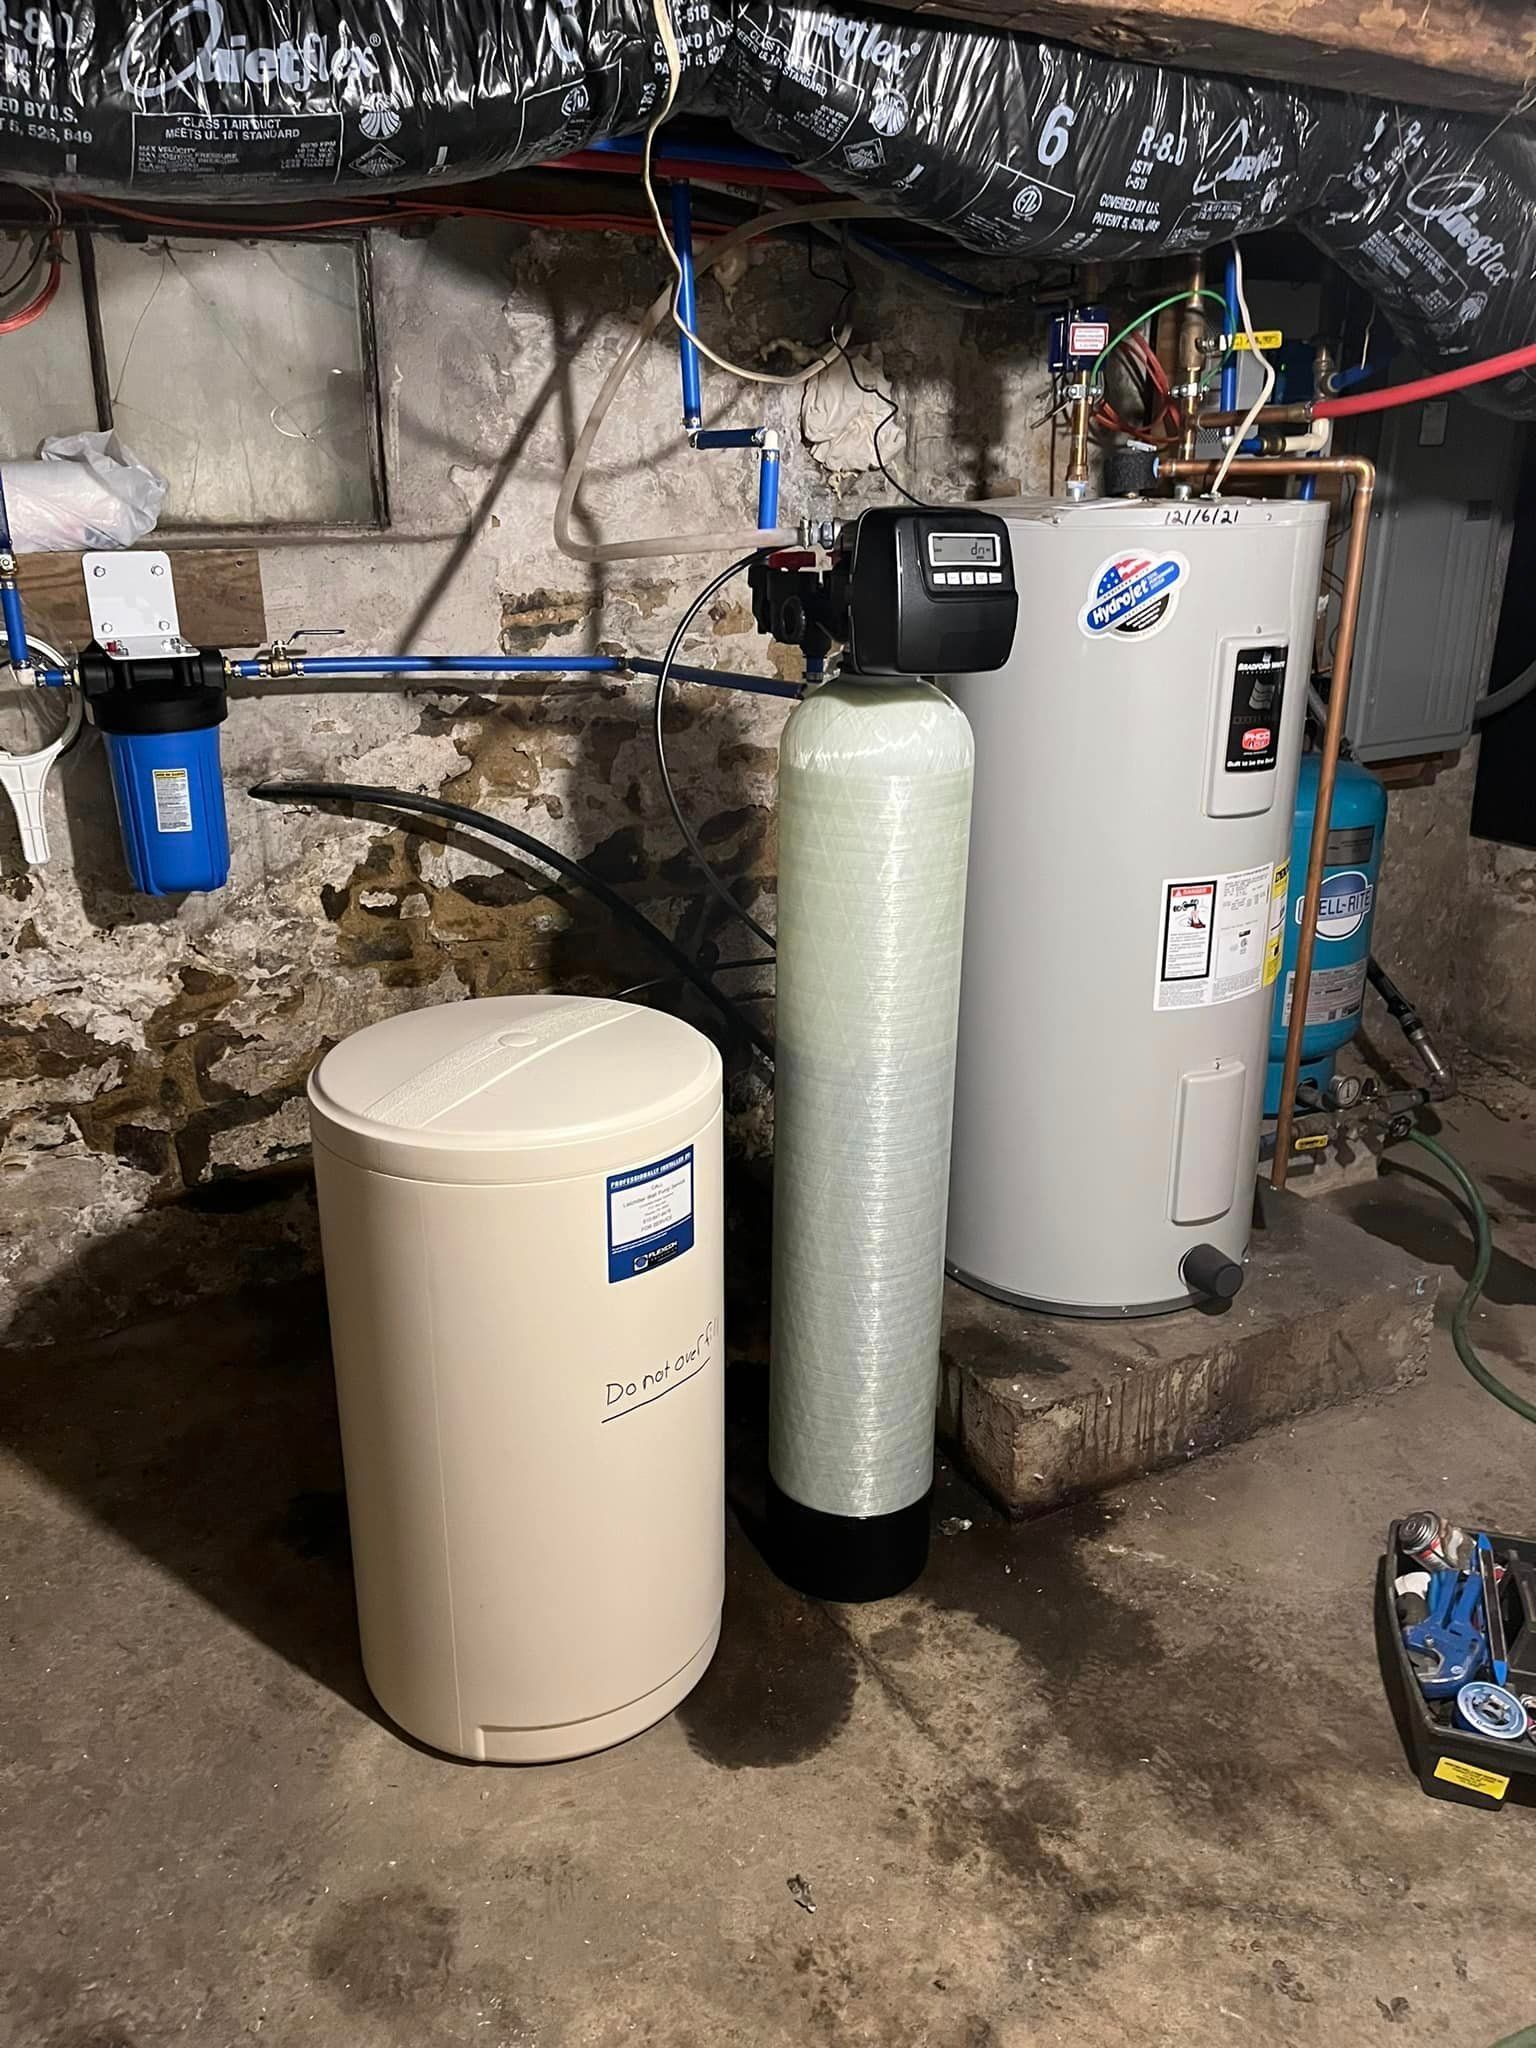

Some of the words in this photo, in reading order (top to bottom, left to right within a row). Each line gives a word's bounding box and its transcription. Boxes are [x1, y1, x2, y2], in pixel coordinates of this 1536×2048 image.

[783, 67, 828, 97] STANDARD
[24, 101, 46, 119] BY
[50, 104, 78, 123] U.S.
[223, 118, 228, 130] 1
[232, 119, 249, 129] AIR
[64, 128, 93, 144] 849
[165, 129, 203, 141] MEETS
[205, 130, 219, 141] UL
[242, 129, 301, 139] STANDARD
[1037, 103, 1075, 167] 6
[1093, 580, 1149, 625] Hydrojet
[1319, 890, 1371, 916] ELL-RITE
[606, 1383, 637, 1406] Do
[642, 1361, 671, 1390] not
